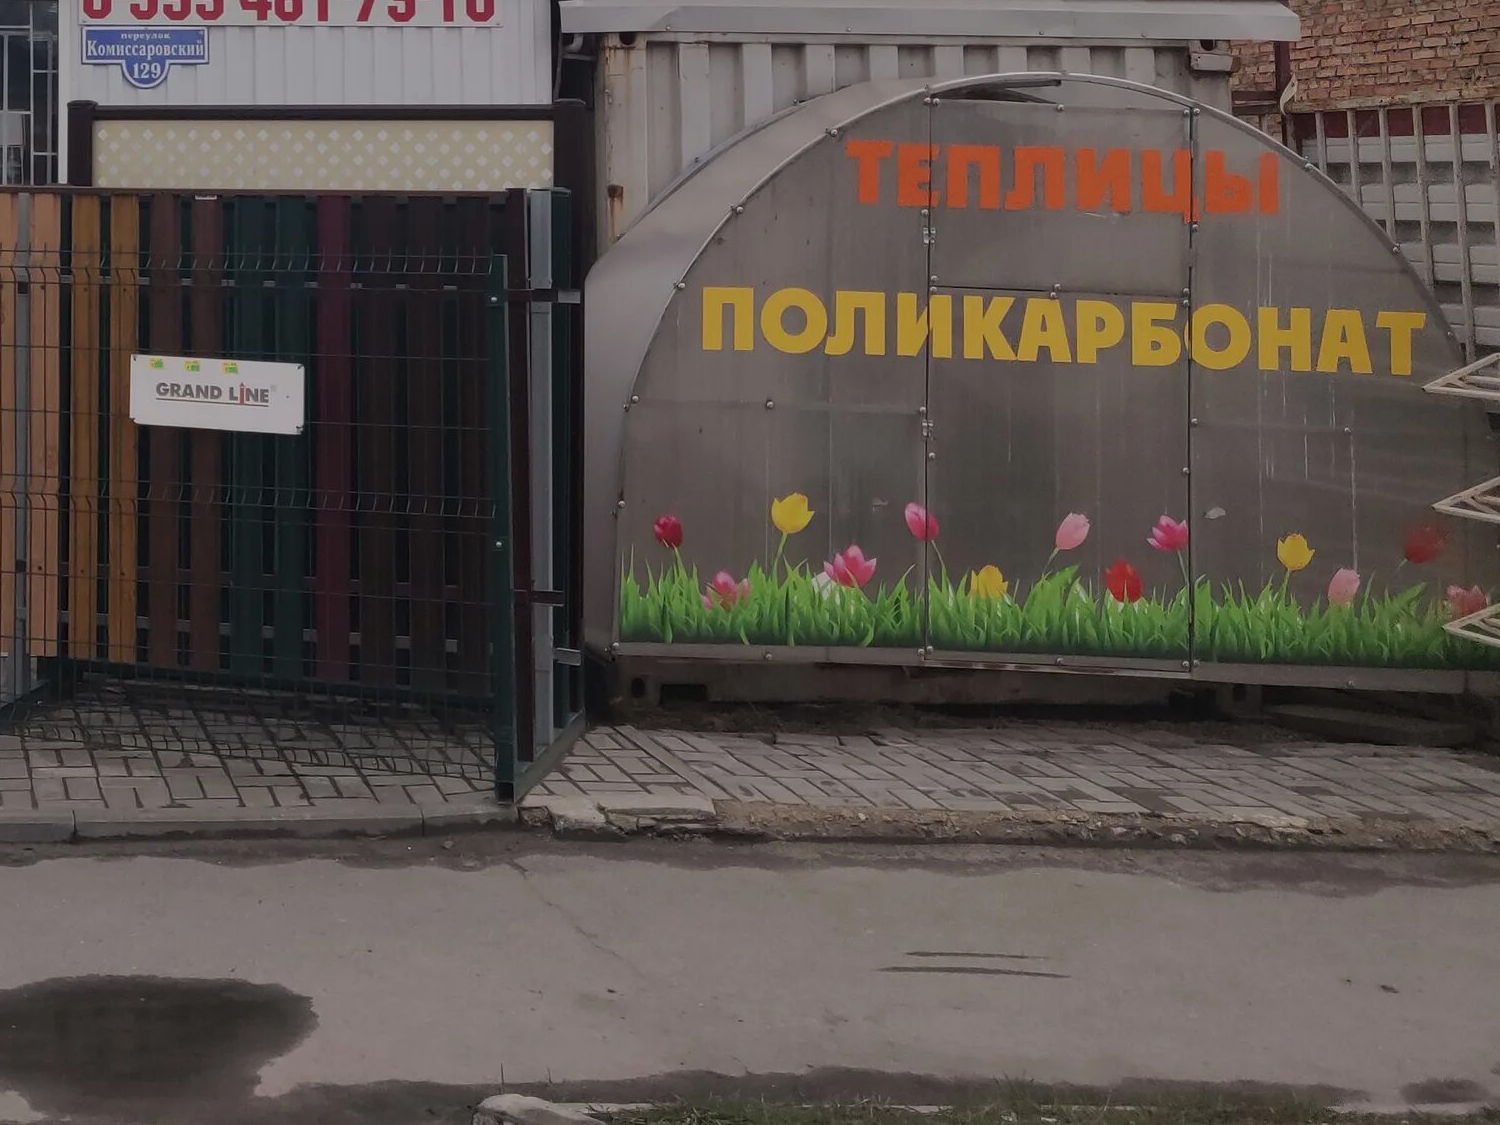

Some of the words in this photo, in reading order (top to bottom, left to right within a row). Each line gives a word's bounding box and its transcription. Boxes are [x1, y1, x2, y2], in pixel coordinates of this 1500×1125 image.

[121, 32, 171, 41] переулок
[86, 39, 204, 60] Комиссаровский
[132, 63, 162, 79] 129
[845, 139, 1280, 223] ТЕПЛИЦЫ
[701, 286, 1426, 375] ПОЛИКАРБОНАТ
[156, 382, 223, 399] GRAND
